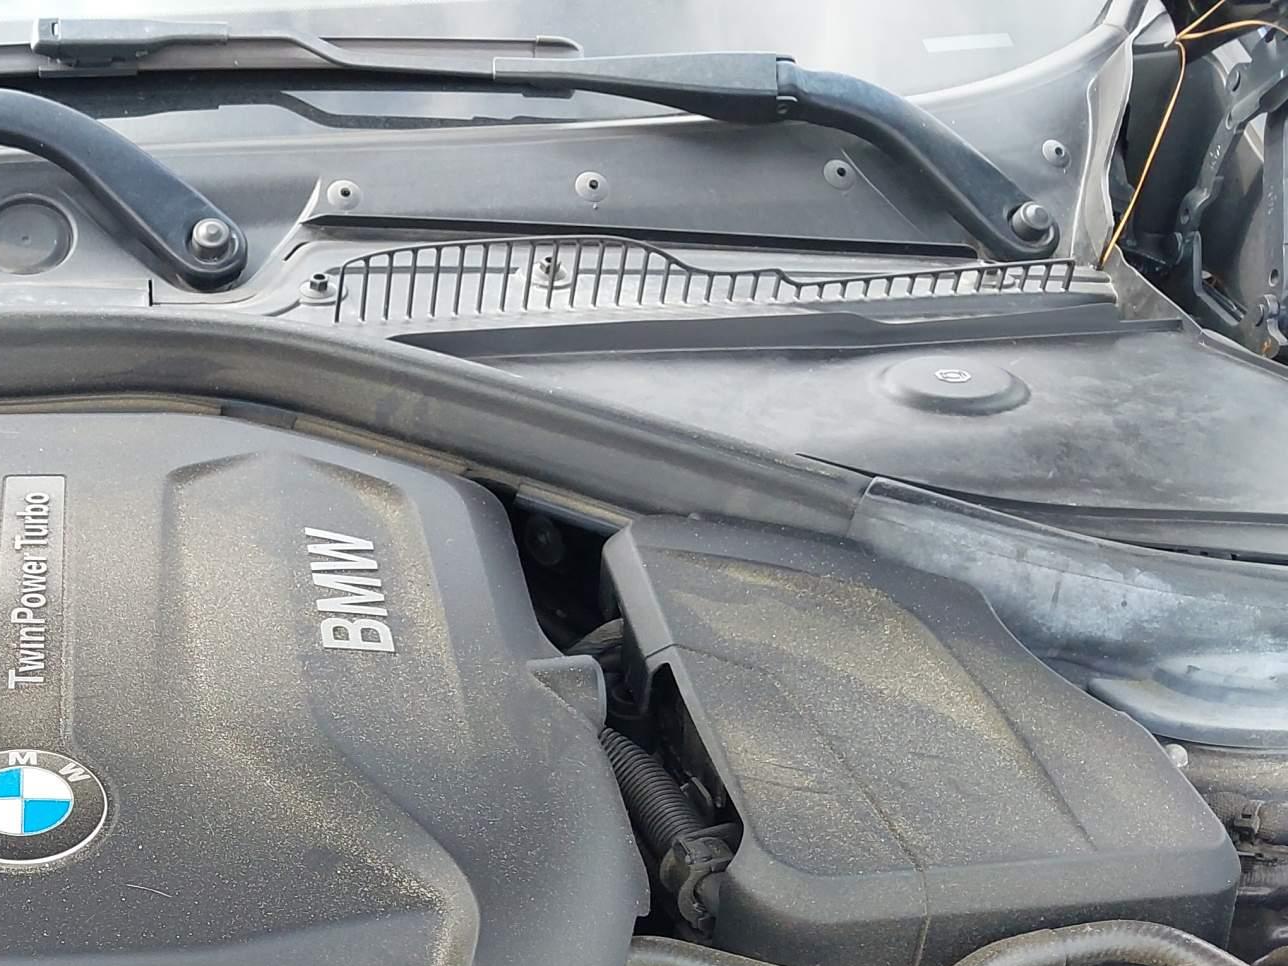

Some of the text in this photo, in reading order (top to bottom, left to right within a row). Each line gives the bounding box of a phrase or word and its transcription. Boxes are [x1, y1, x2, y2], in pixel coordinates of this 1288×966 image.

[8, 492, 50, 689] TwinPower Turbo
[304, 527, 396, 652] BMW
